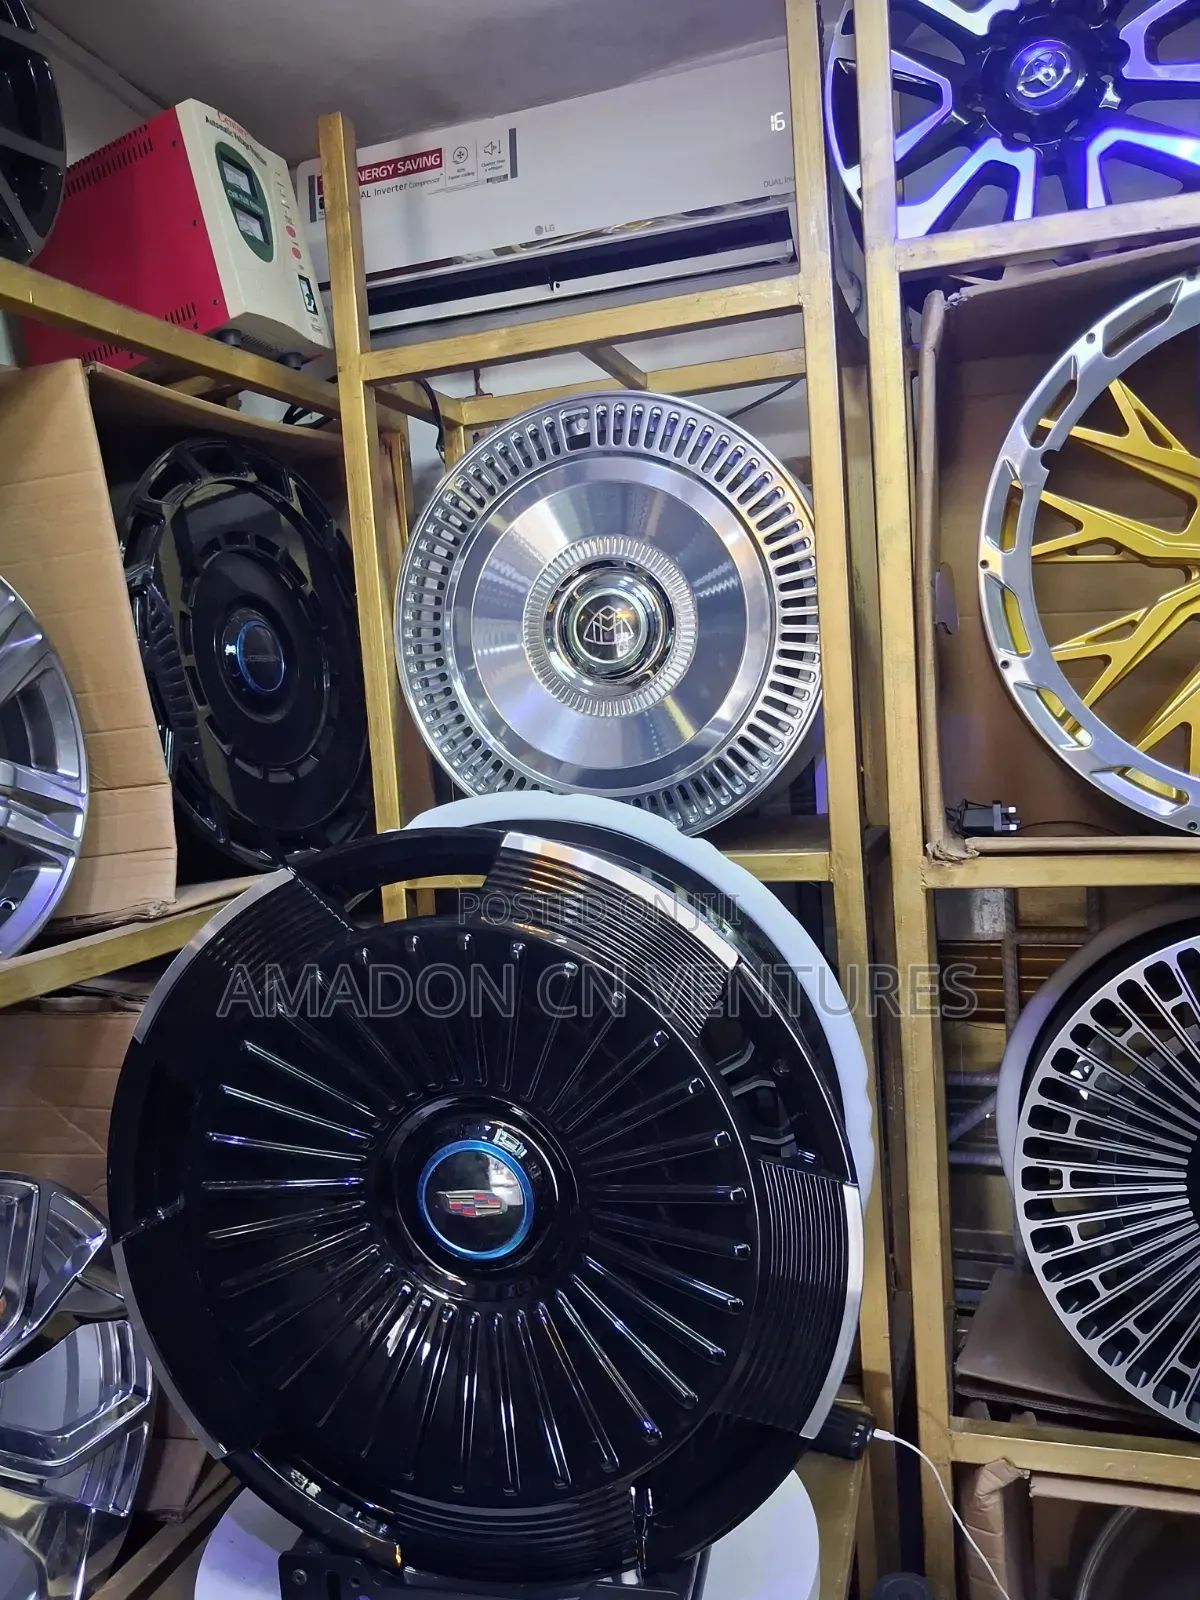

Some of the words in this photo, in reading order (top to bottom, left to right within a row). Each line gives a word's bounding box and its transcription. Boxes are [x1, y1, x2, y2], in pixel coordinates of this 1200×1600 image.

[770, 112, 786, 131] 16
[358, 163, 395, 182] NERGY
[397, 153, 441, 173] SAVING
[359, 190, 372, 199] AL
[374, 183, 408, 197] Inverter
[409, 177, 441, 189] Compressor
[763, 178, 784, 188] DUAL
[544, 223, 556, 233] LG
